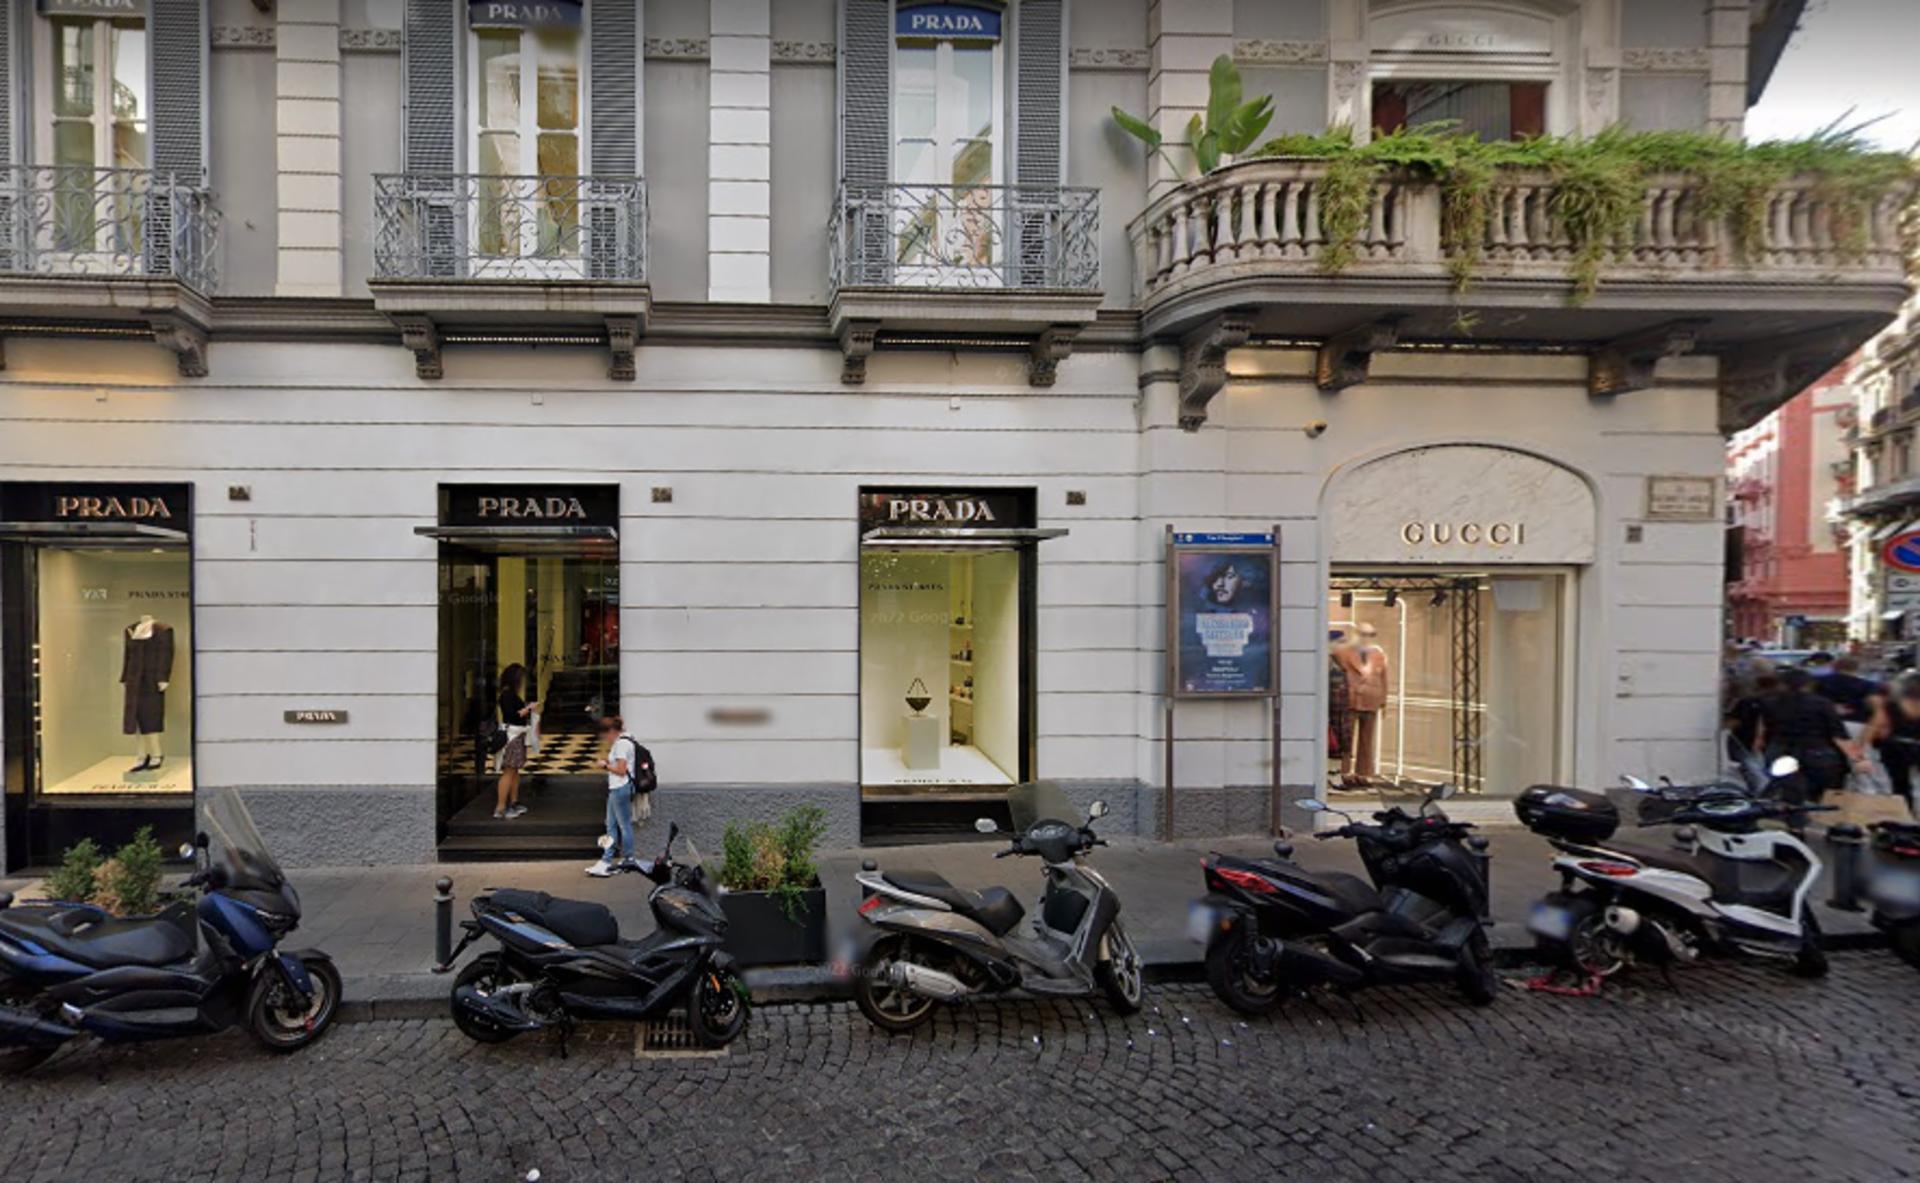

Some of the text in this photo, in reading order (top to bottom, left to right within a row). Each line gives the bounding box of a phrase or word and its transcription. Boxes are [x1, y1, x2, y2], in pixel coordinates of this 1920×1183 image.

[488, 4, 561, 19] PRADA
[911, 14, 983, 30] PRADA
[1427, 33, 1494, 47] GUCCI
[56, 496, 172, 519] PRADA
[477, 496, 587, 519] PRADA
[888, 499, 996, 521] PRADA
[1401, 520, 1525, 545] GUCCI
